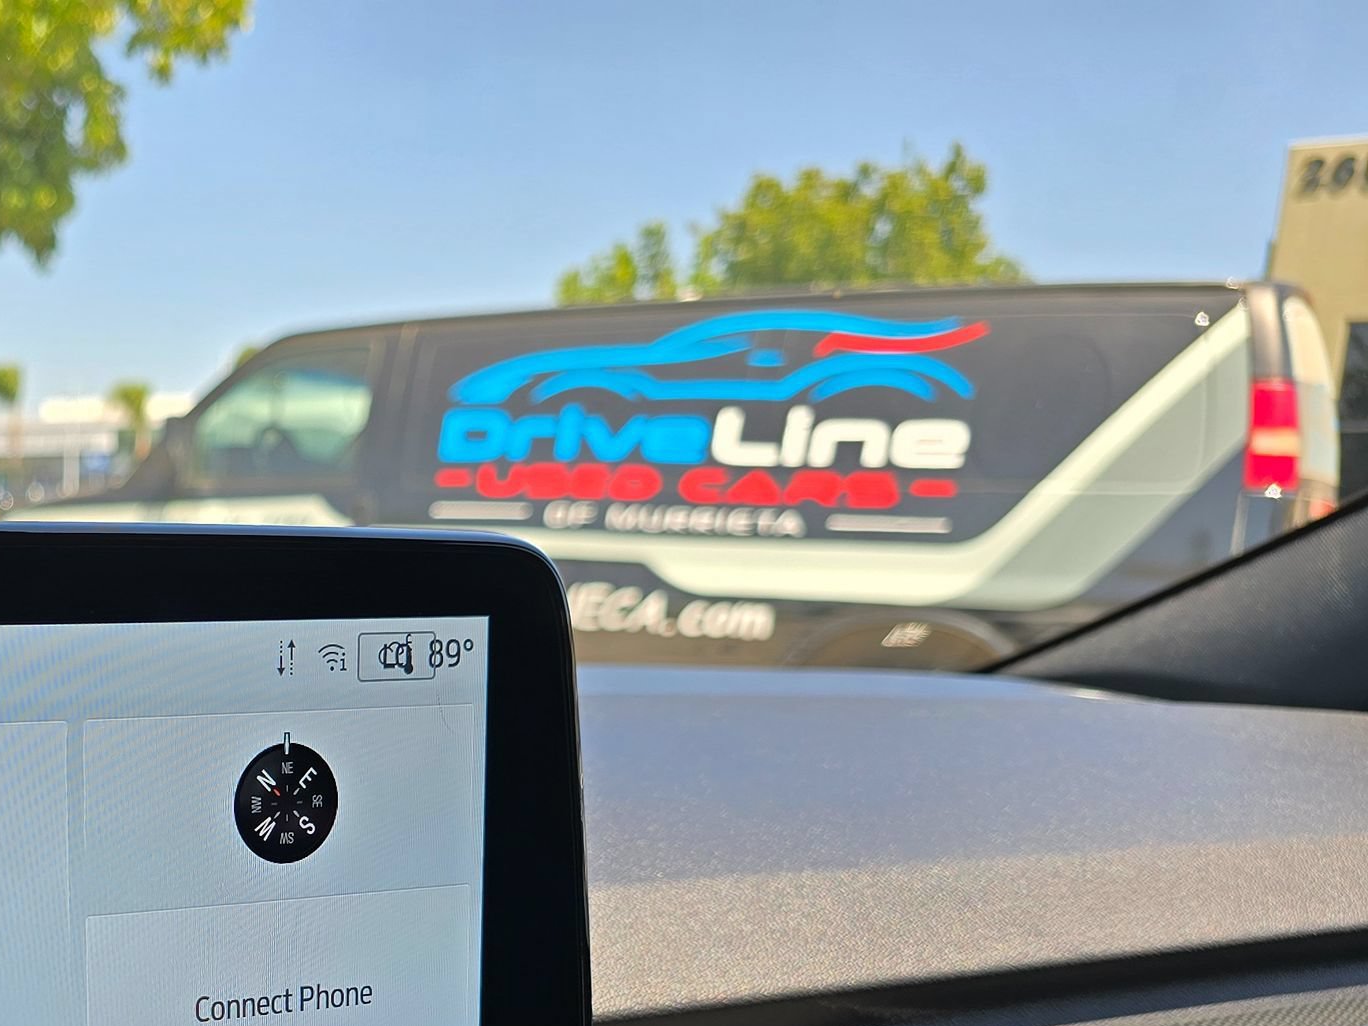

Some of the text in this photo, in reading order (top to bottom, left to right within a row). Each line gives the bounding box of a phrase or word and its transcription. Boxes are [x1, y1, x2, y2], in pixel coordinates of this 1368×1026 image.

[256, 768, 277, 792] N
[298, 766, 318, 789] E
[254, 816, 276, 841] W
[299, 815, 316, 835] S
[195, 983, 373, 1023] Connect Phone
